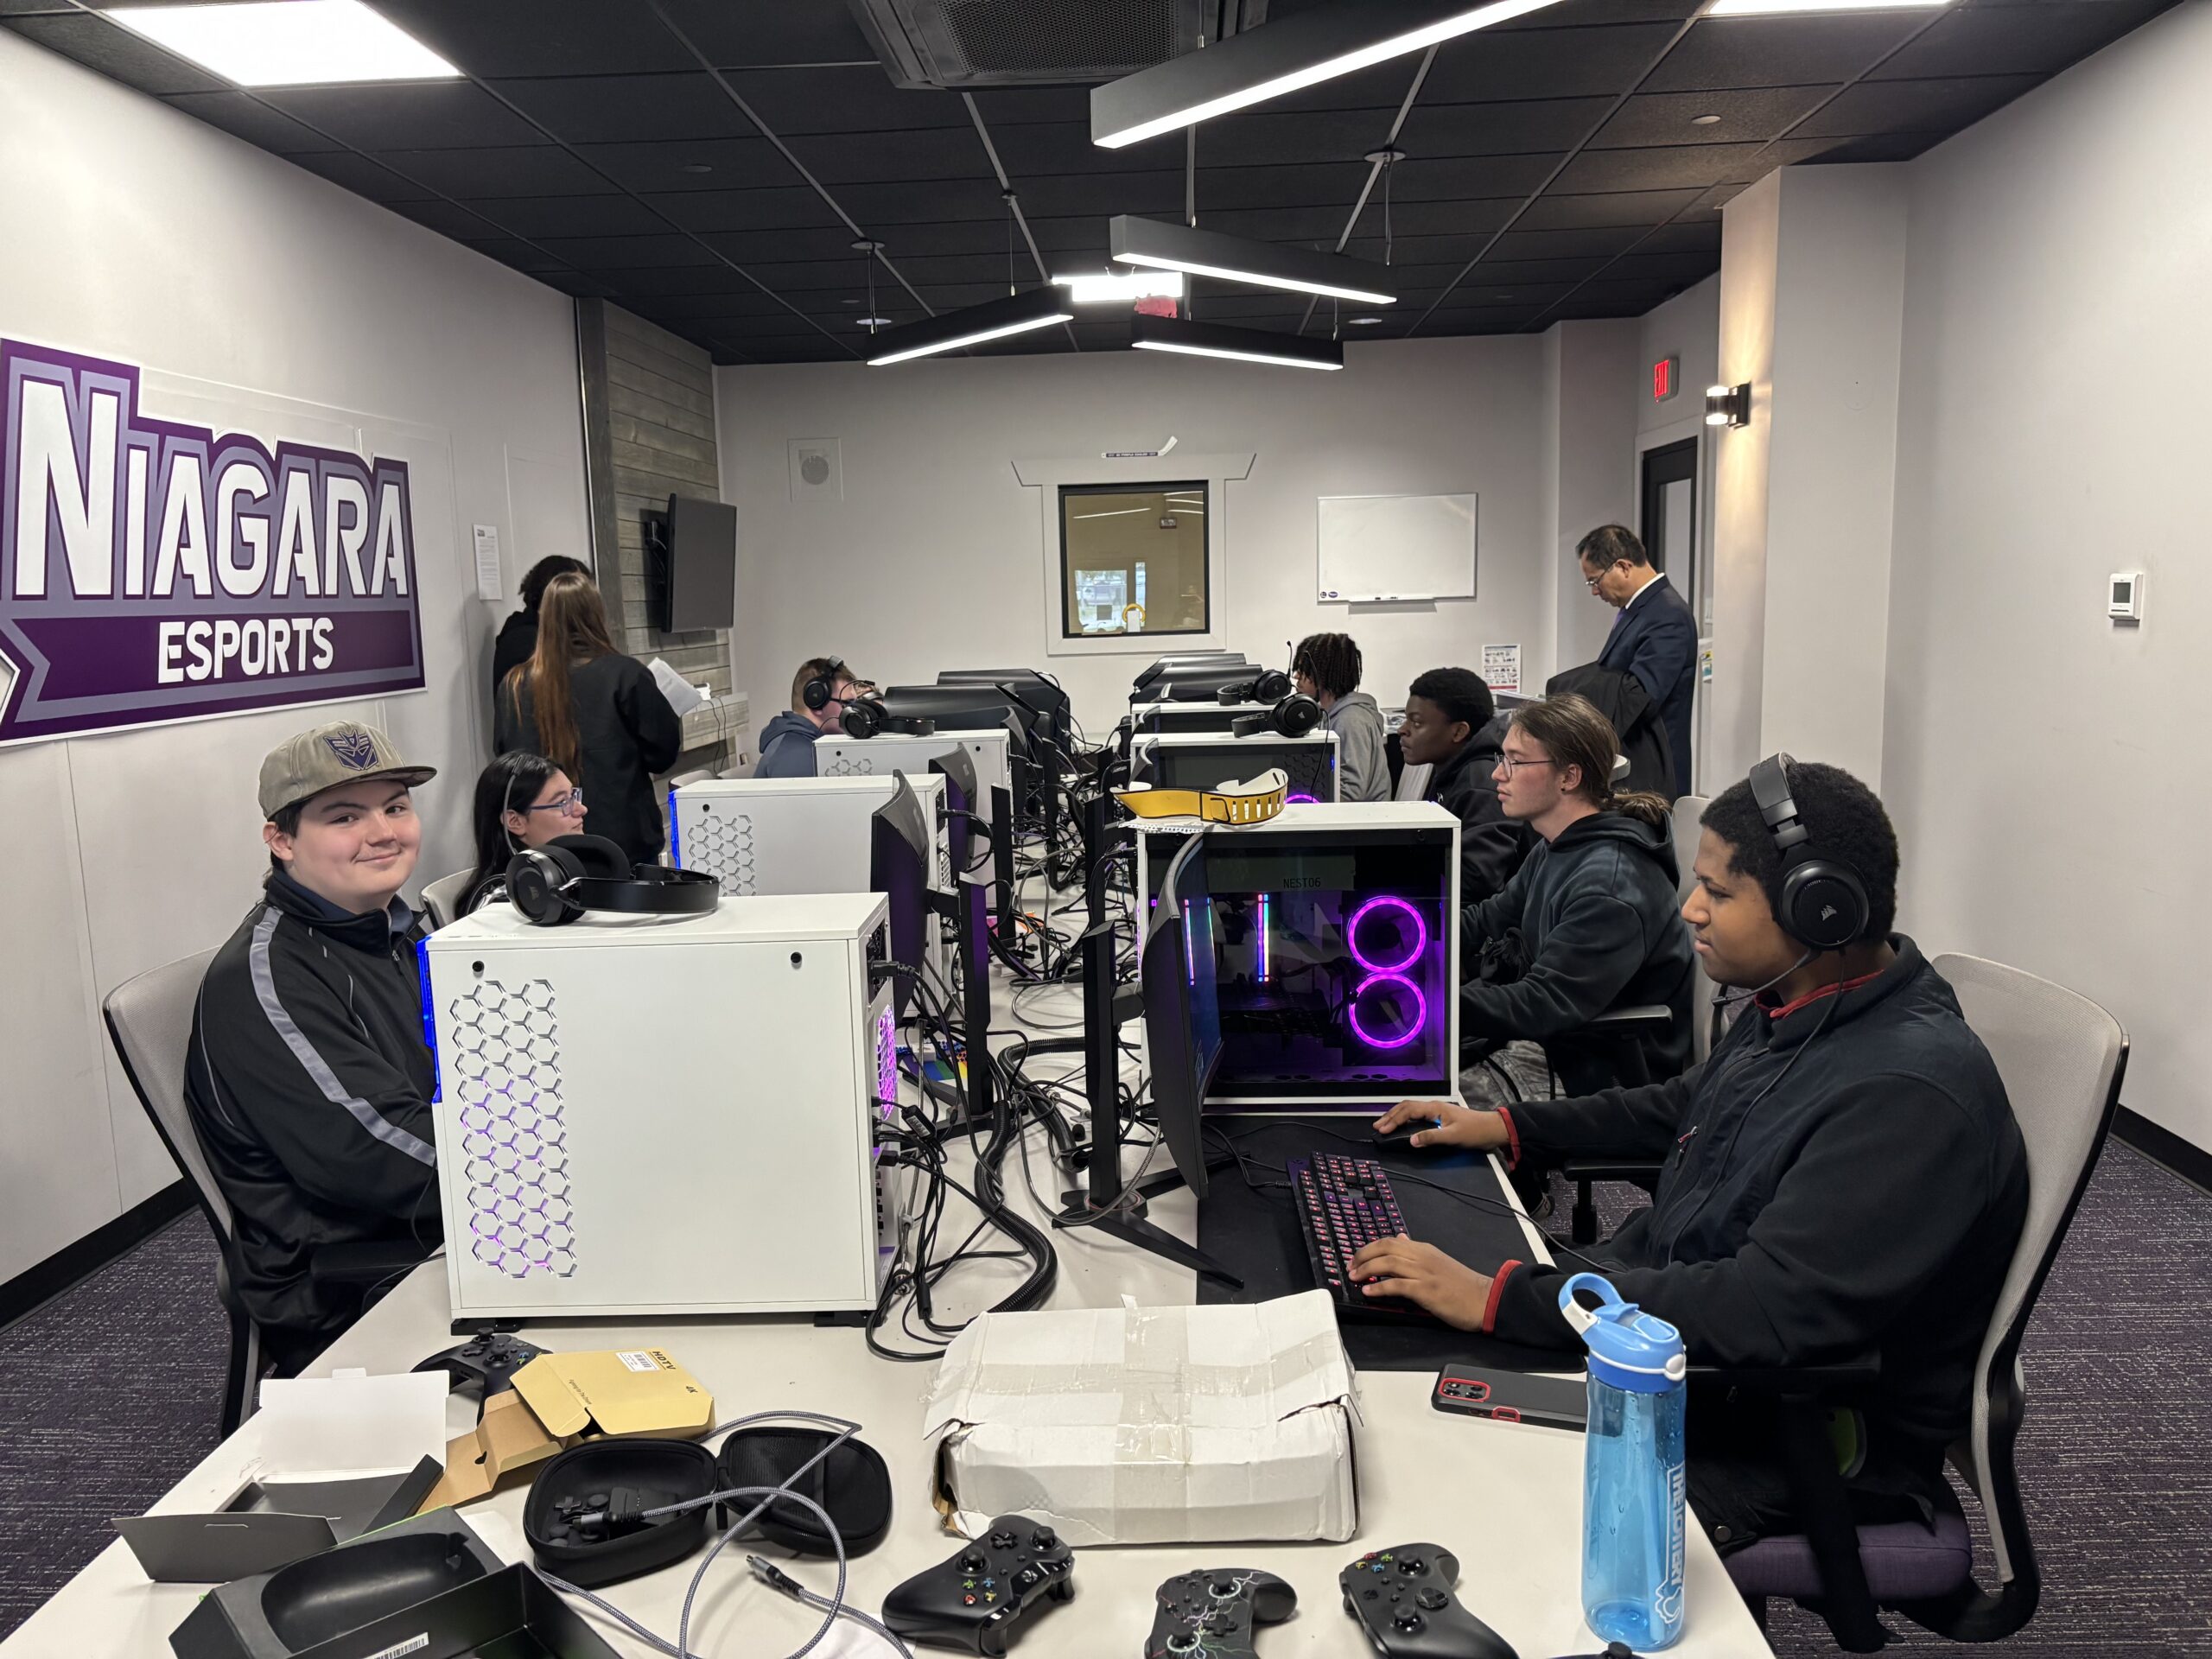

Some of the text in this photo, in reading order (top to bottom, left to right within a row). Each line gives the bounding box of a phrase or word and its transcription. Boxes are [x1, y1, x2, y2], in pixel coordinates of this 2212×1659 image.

[1654, 359, 1669, 397] EXIT
[16, 378, 408, 596] NIAGARA
[157, 617, 334, 684] ESPORTS
[1283, 877, 1321, 888] NEST06
[652, 1351, 676, 1370] HDTV
[1671, 1471, 1684, 1586] THE LOTTERY
